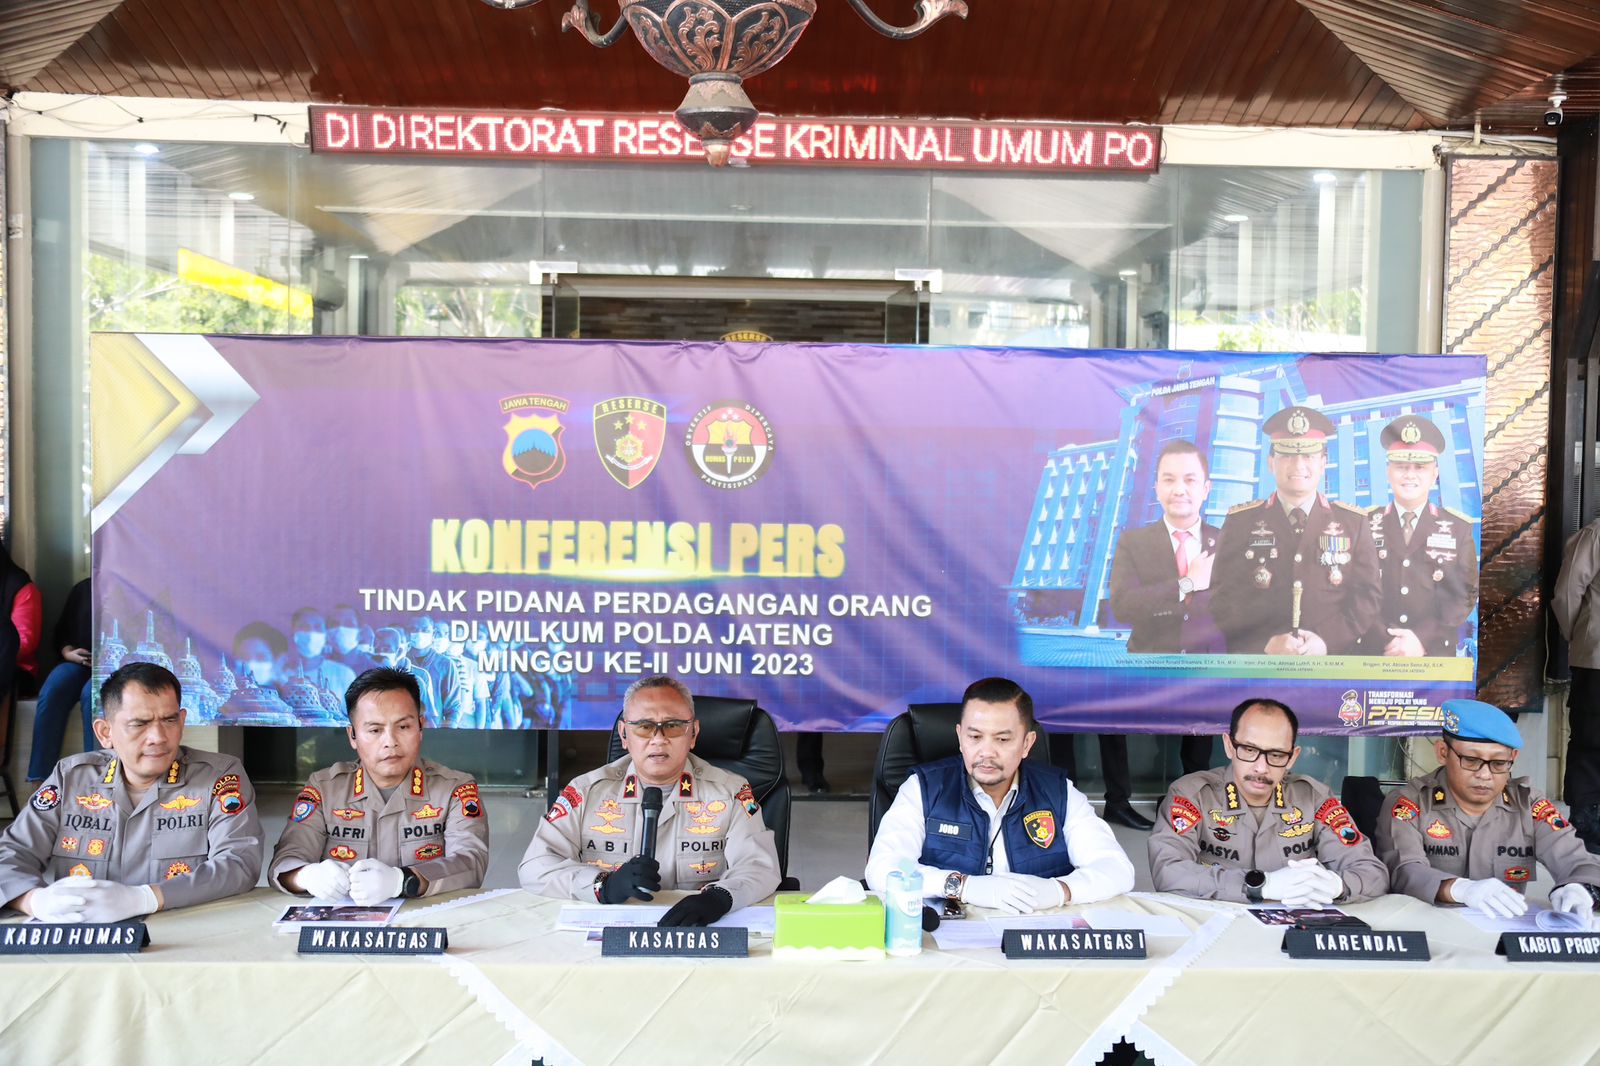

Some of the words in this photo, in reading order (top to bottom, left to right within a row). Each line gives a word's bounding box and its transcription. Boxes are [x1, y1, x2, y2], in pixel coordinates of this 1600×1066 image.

[326, 113, 359, 149] DI
[373, 114, 605, 155] DIREKTORAT
[613, 119, 776, 159] RESESE
[785, 124, 965, 163] KRIMINAL
[972, 128, 1094, 166] UMUM
[1104, 132, 1153, 167] PO
[503, 398, 528, 410] JAWA
[528, 397, 567, 411] TENGAH
[601, 398, 658, 414] RESERSE
[701, 474, 757, 489] PARTISIPASI
[432, 518, 713, 579] KONFERENSI
[729, 523, 845, 578] PERS
[359, 588, 467, 613] TINDAK
[476, 590, 584, 615] PIDANA
[594, 591, 819, 617] PERDAGANGAN
[827, 594, 932, 618] ORANG
[451, 620, 478, 643] DI
[485, 620, 604, 644] WILKUM
[614, 621, 713, 645] POLDA
[720, 622, 834, 647] JATENG
[477, 650, 594, 675] MINGGU
[603, 651, 669, 675] KE-II
[677, 652, 743, 676] JUNI
[751, 652, 814, 676] 2023
[1368, 690, 1414, 699] TRANSFORMASI
[1368, 705, 1444, 721] PRESI
[211, 775, 238, 796] POLDA
[64, 813, 113, 832] IQBAL
[157, 813, 204, 831] POLRI
[1325, 808, 1345, 825] POLDA
[681, 839, 724, 852] POLRI
[4, 926, 64, 946] KABID
[68, 926, 135, 946] HUMAS
[311, 928, 428, 949] WAKASATGAS
[628, 931, 720, 949] KASATGAS
[1020, 933, 1134, 951] WAKASATGAS
[1314, 933, 1408, 953] KARENDAL
[1518, 936, 1561, 954] KABID
